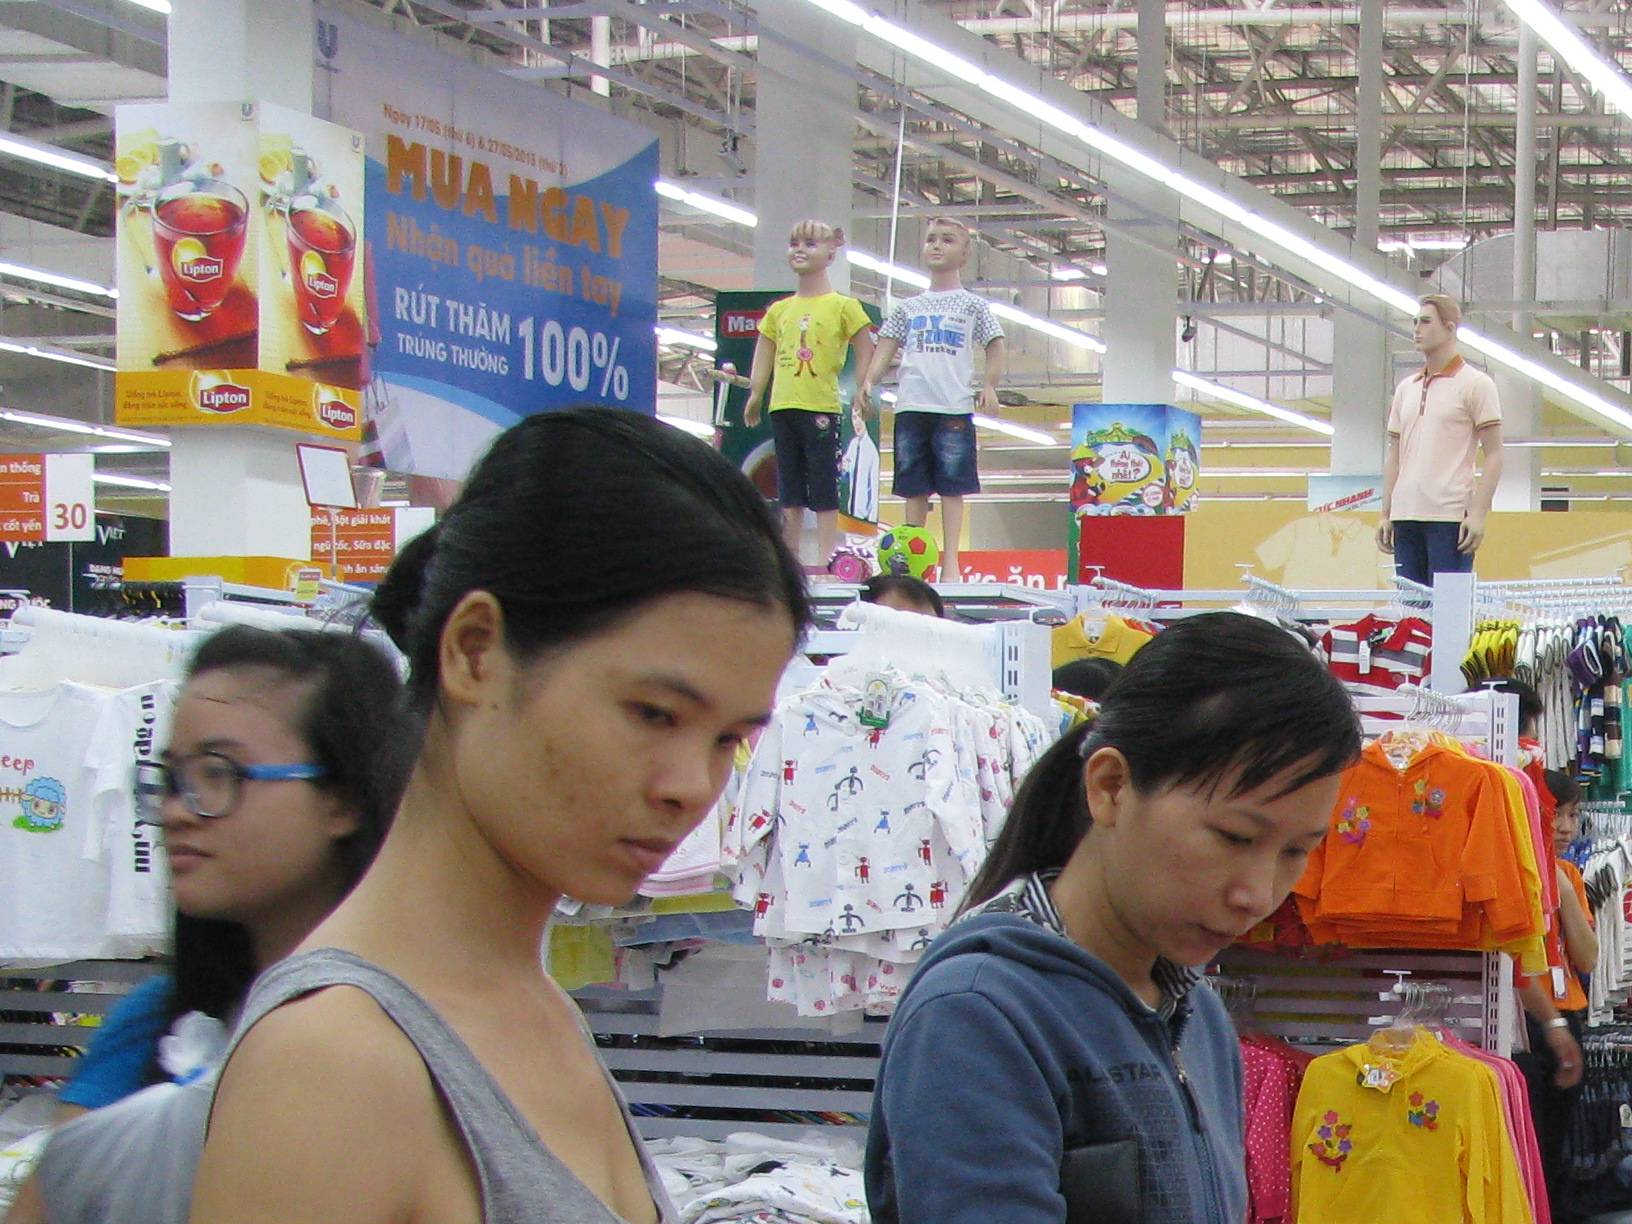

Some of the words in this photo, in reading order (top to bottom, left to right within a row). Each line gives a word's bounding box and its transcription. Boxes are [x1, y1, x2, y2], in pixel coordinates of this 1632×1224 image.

[386, 133, 498, 224] MUA
[509, 173, 630, 258] NGAY
[183, 262, 220, 276] Lipton
[386, 211, 458, 271] Nhận
[582, 266, 622, 318] tay
[308, 278, 335, 294] Lipton
[395, 283, 440, 328] RÚT
[446, 301, 511, 345] THĂM
[397, 332, 447, 362] TRÚNG
[518, 316, 629, 400] 100%
[203, 391, 247, 407] Lipton
[322, 404, 354, 423] Lipton
[54, 503, 87, 530] 30
[1, 755, 35, 776] eep
